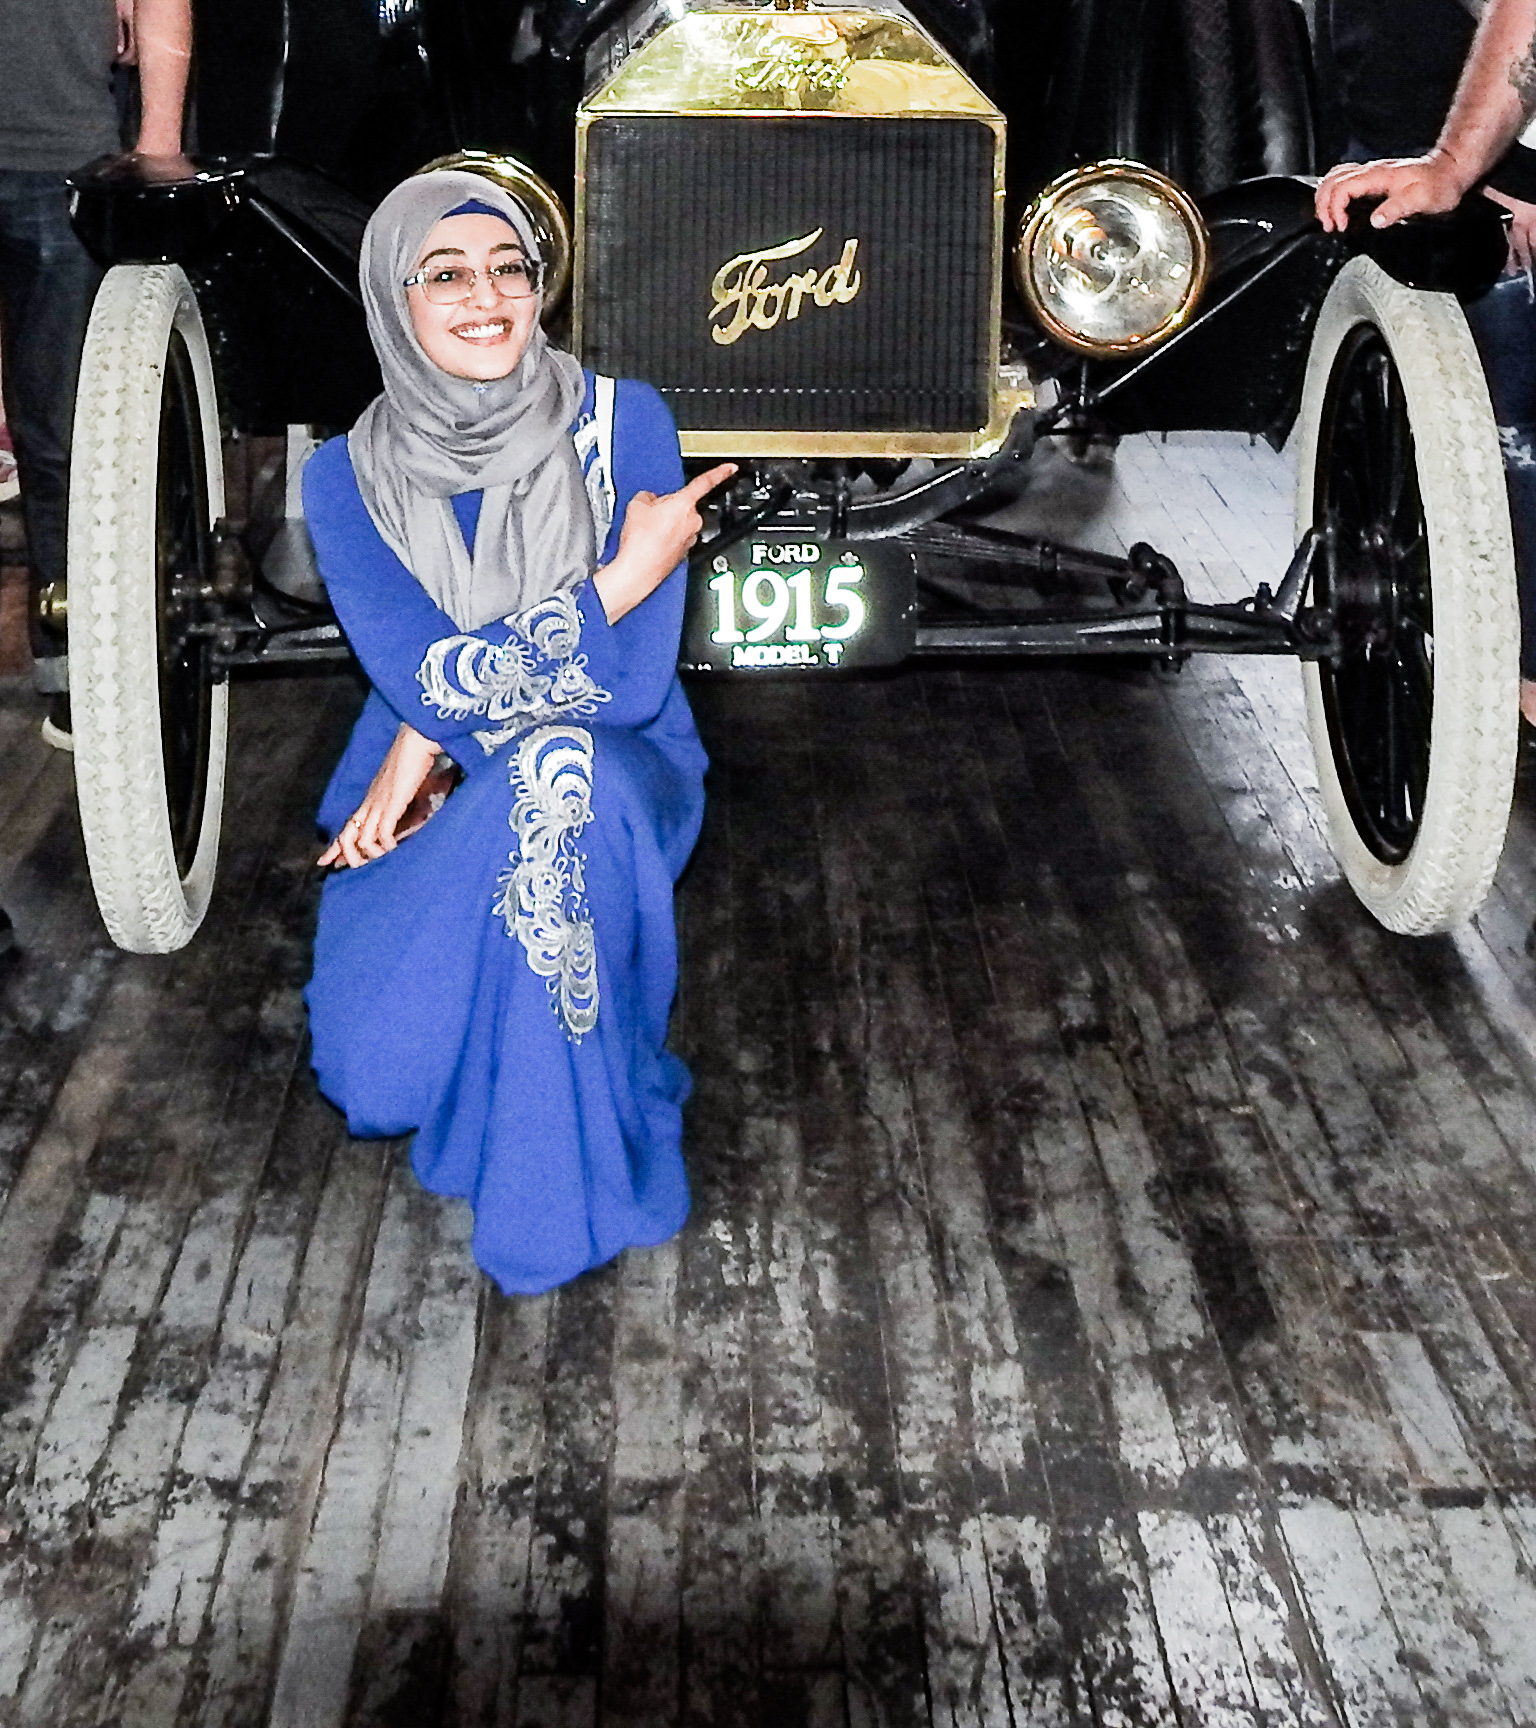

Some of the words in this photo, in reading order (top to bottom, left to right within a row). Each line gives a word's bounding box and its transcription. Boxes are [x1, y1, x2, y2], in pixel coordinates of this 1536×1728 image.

[708, 227, 861, 345] Ford
[751, 543, 820, 565] FORD
[708, 564, 864, 644] 1915
[732, 644, 819, 667] MODEL
[822, 642, 844, 665] T
